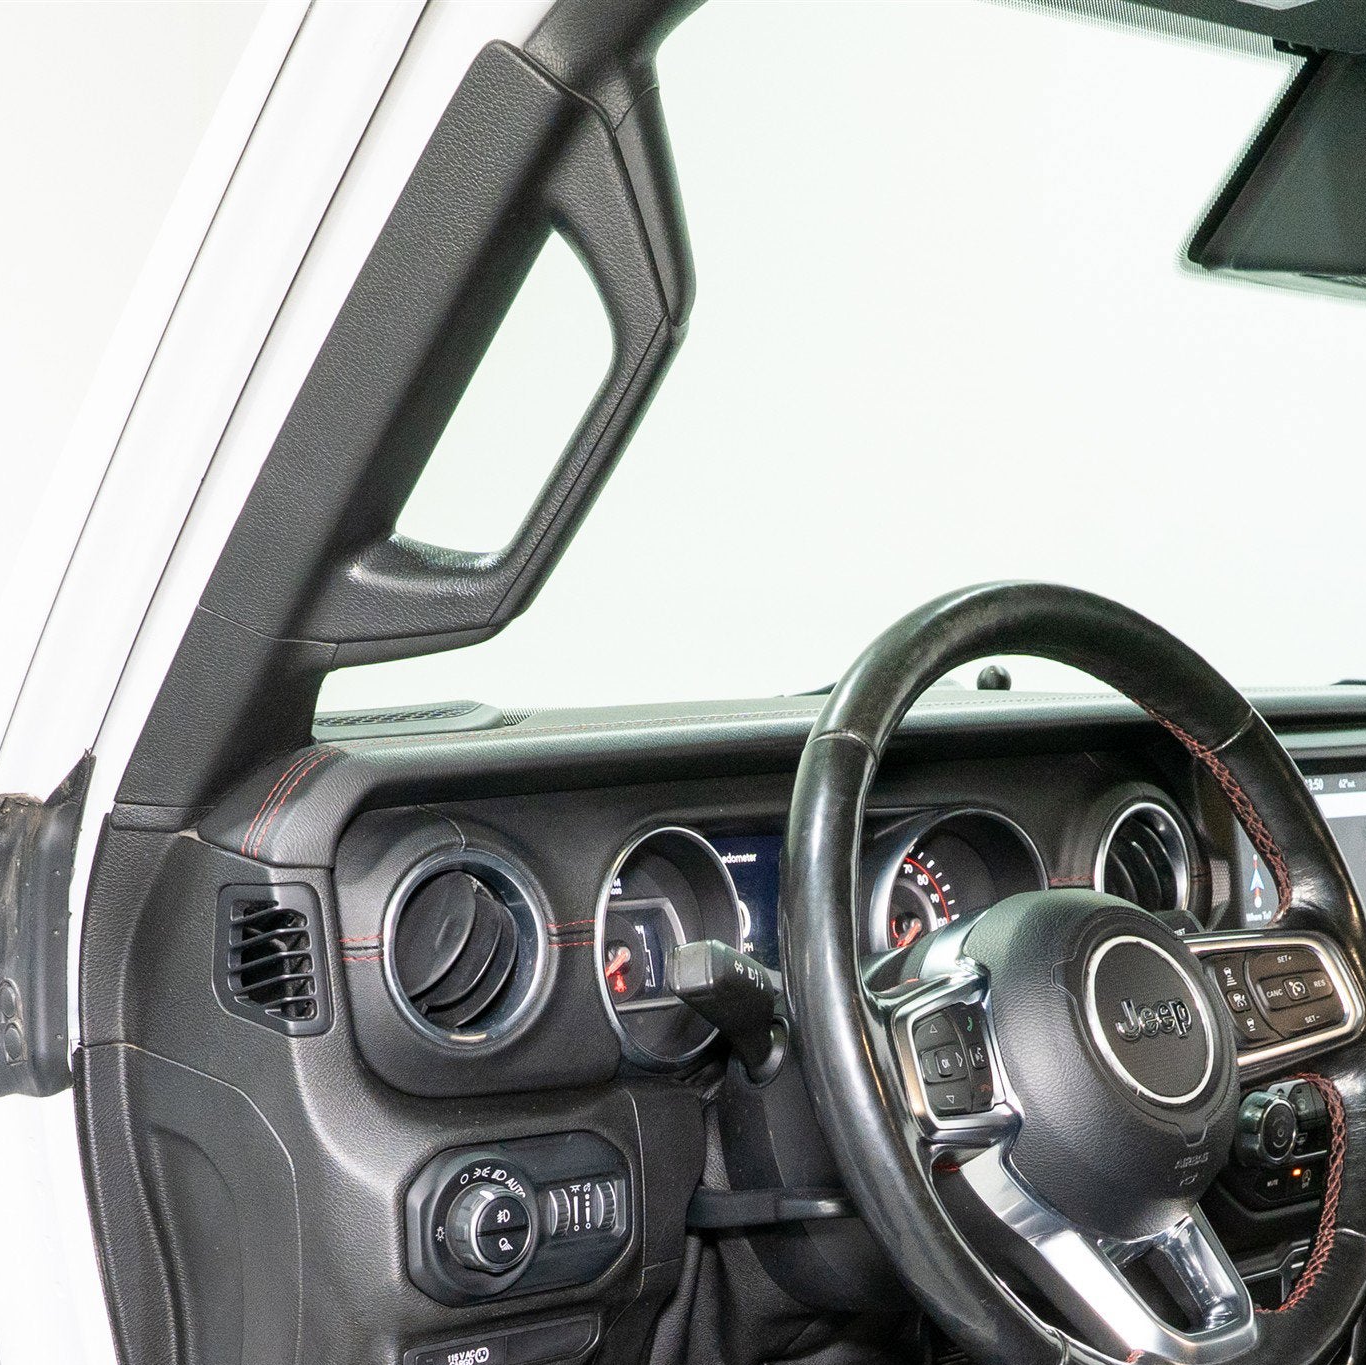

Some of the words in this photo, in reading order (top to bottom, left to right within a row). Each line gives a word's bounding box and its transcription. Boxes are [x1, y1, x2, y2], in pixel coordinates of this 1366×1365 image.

[720, 852, 757, 864] edometer
[916, 873, 929, 886] 80
[743, 941, 754, 952] PH
[1313, 979, 1327, 988] RES
[1266, 988, 1284, 999] CANC
[1115, 998, 1192, 1041] Jeep
